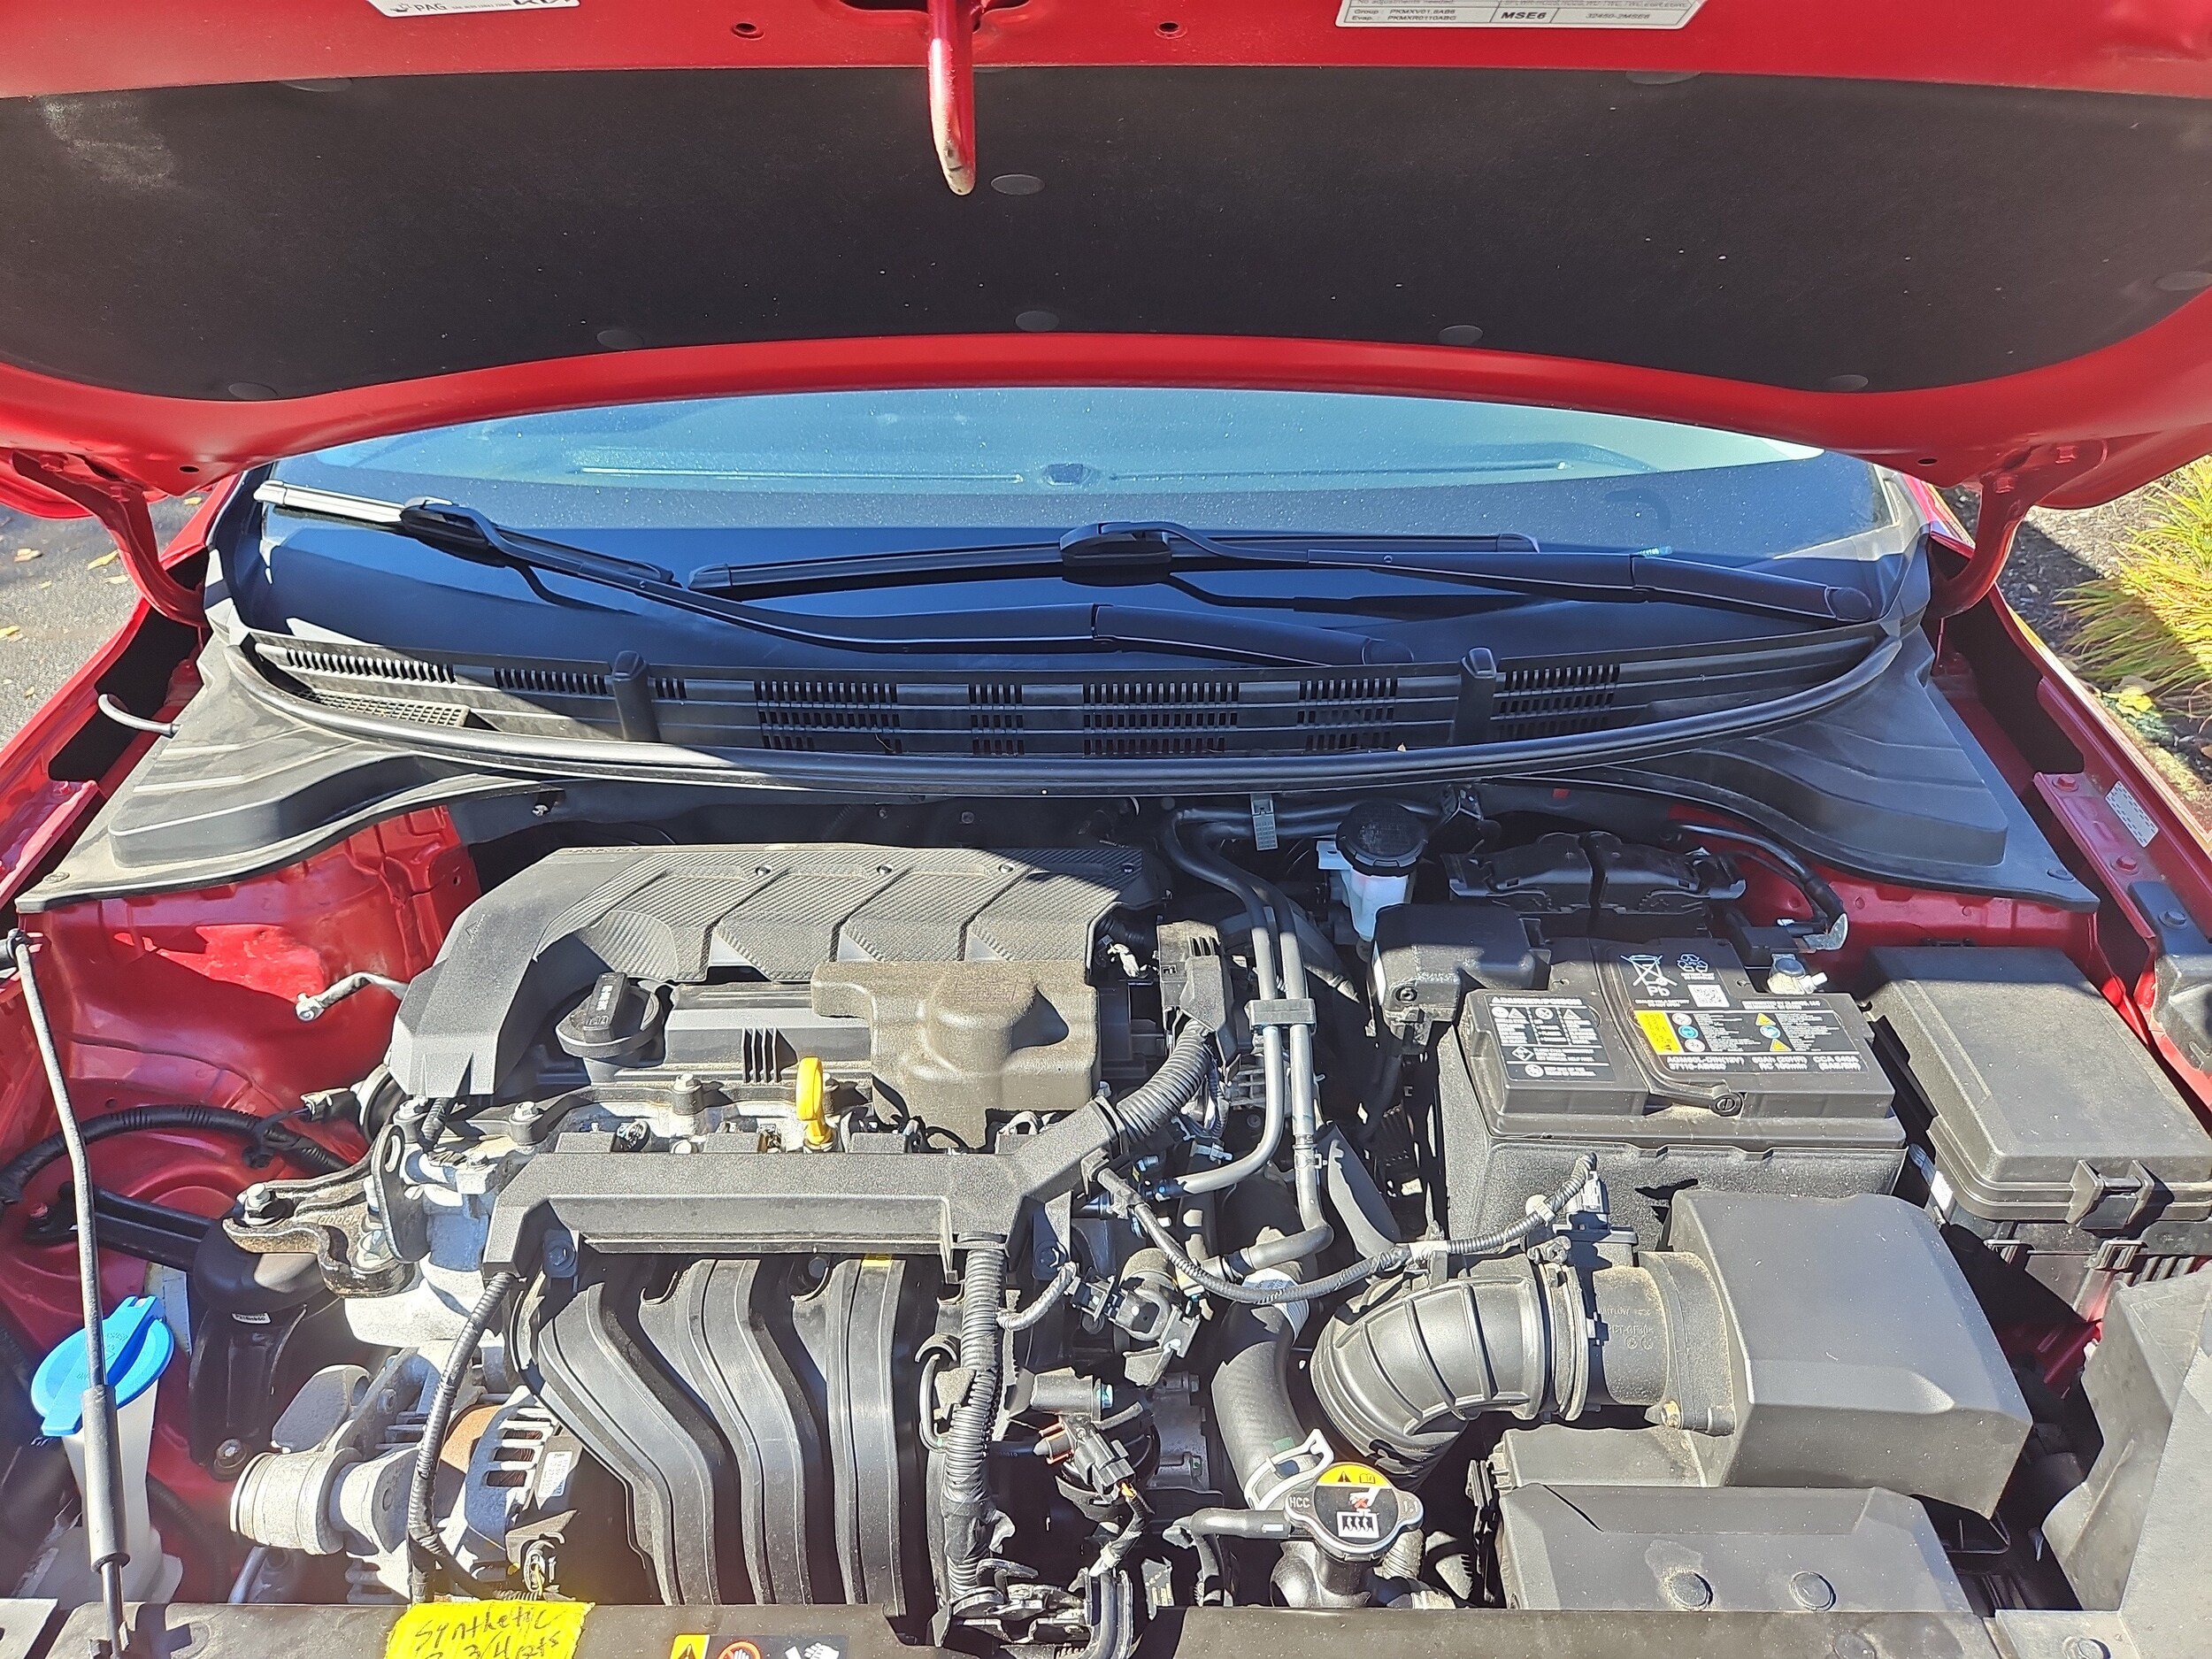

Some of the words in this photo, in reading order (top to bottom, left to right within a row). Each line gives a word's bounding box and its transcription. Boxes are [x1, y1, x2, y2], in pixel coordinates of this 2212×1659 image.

[414, 4, 447, 12] PAG
[1647, 986, 1671, 996] Pb
[1288, 1496, 1311, 1509] HCC
